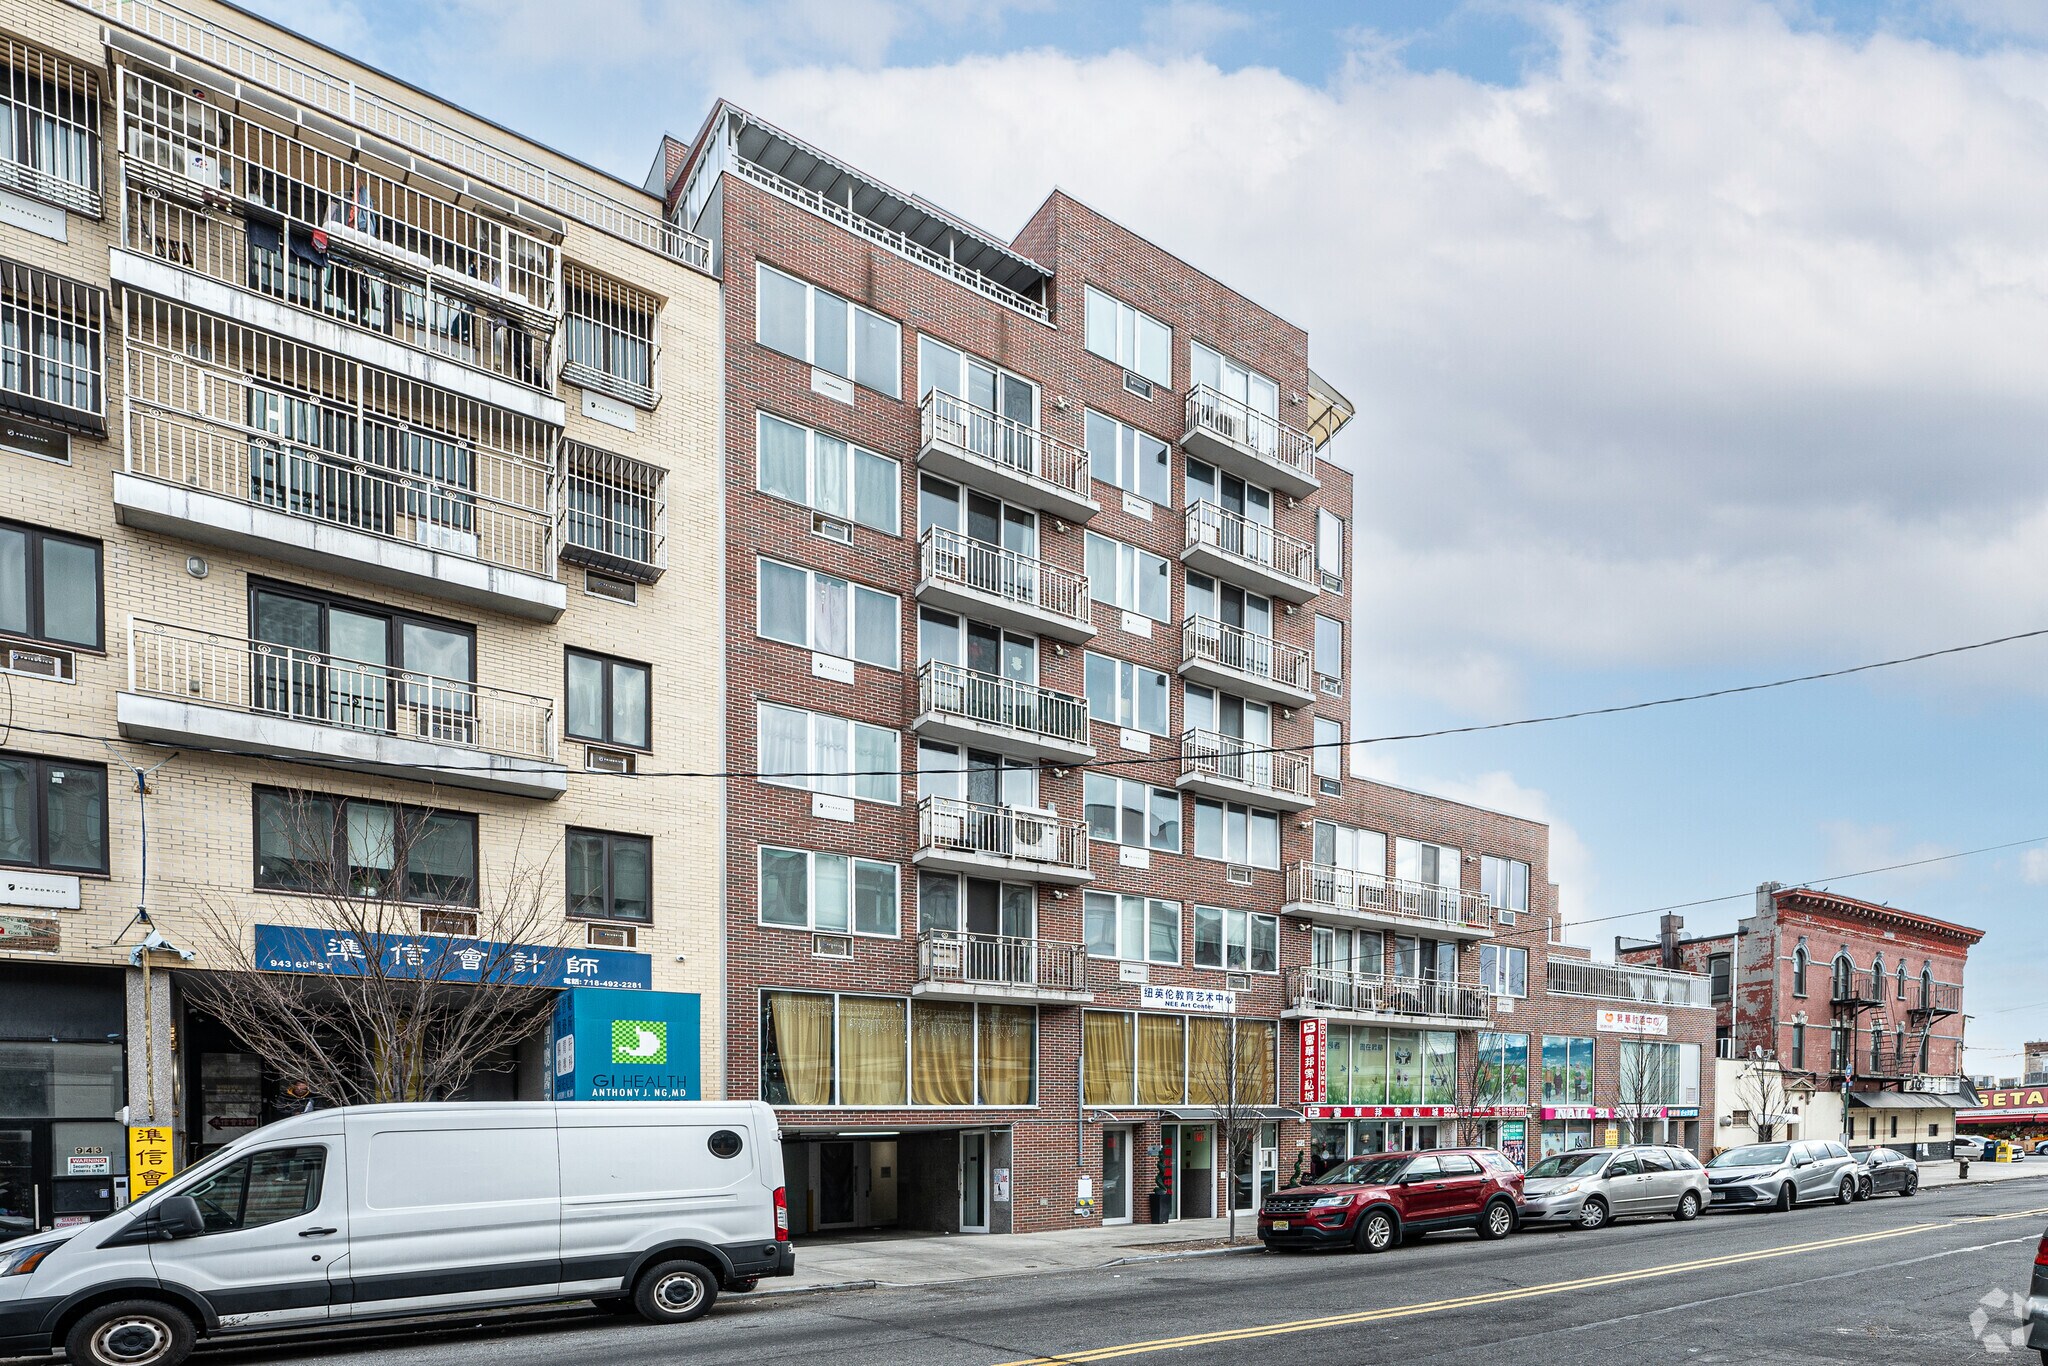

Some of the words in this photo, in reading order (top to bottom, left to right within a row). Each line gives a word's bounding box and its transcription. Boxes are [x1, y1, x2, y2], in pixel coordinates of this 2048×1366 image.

[5, 204, 53, 223] FRIEDRICH
[15, 432, 49, 443] FRIEDRICH
[19, 886, 66, 895] FRIEDRICH
[326, 938, 600, 977] 準信會計師
[270, 959, 292, 968] 943
[583, 979, 642, 989] 718-492-2281
[592, 1074, 615, 1088] GI
[623, 1075, 687, 1088] HEALTH
[592, 1088, 640, 1097] ANTHONY
[643, 1089, 651, 1097] J.
[654, 1089, 687, 1098] NG,MD
[1554, 1108, 1591, 1119] NAIL
[75, 1147, 103, 1155] 943
